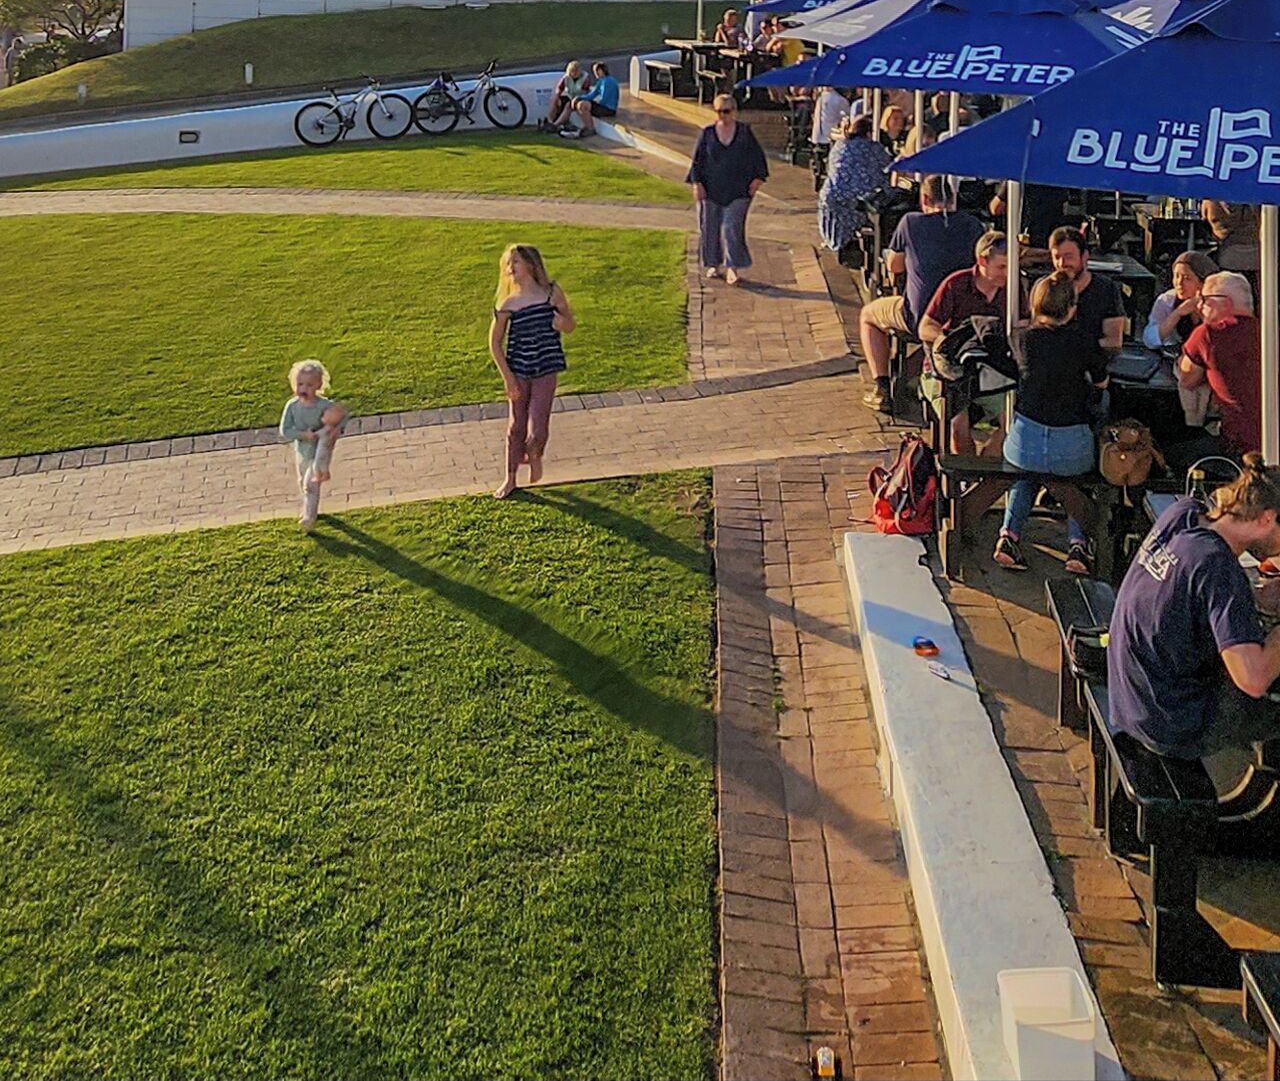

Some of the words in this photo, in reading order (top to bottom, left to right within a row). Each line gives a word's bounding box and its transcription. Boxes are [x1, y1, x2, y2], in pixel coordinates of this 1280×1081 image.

[927, 51, 955, 61] THE
[862, 57, 958, 80] BLUE
[961, 61, 1076, 85] PETER
[1158, 119, 1201, 138] THE
[1066, 128, 1214, 179] BLUE
